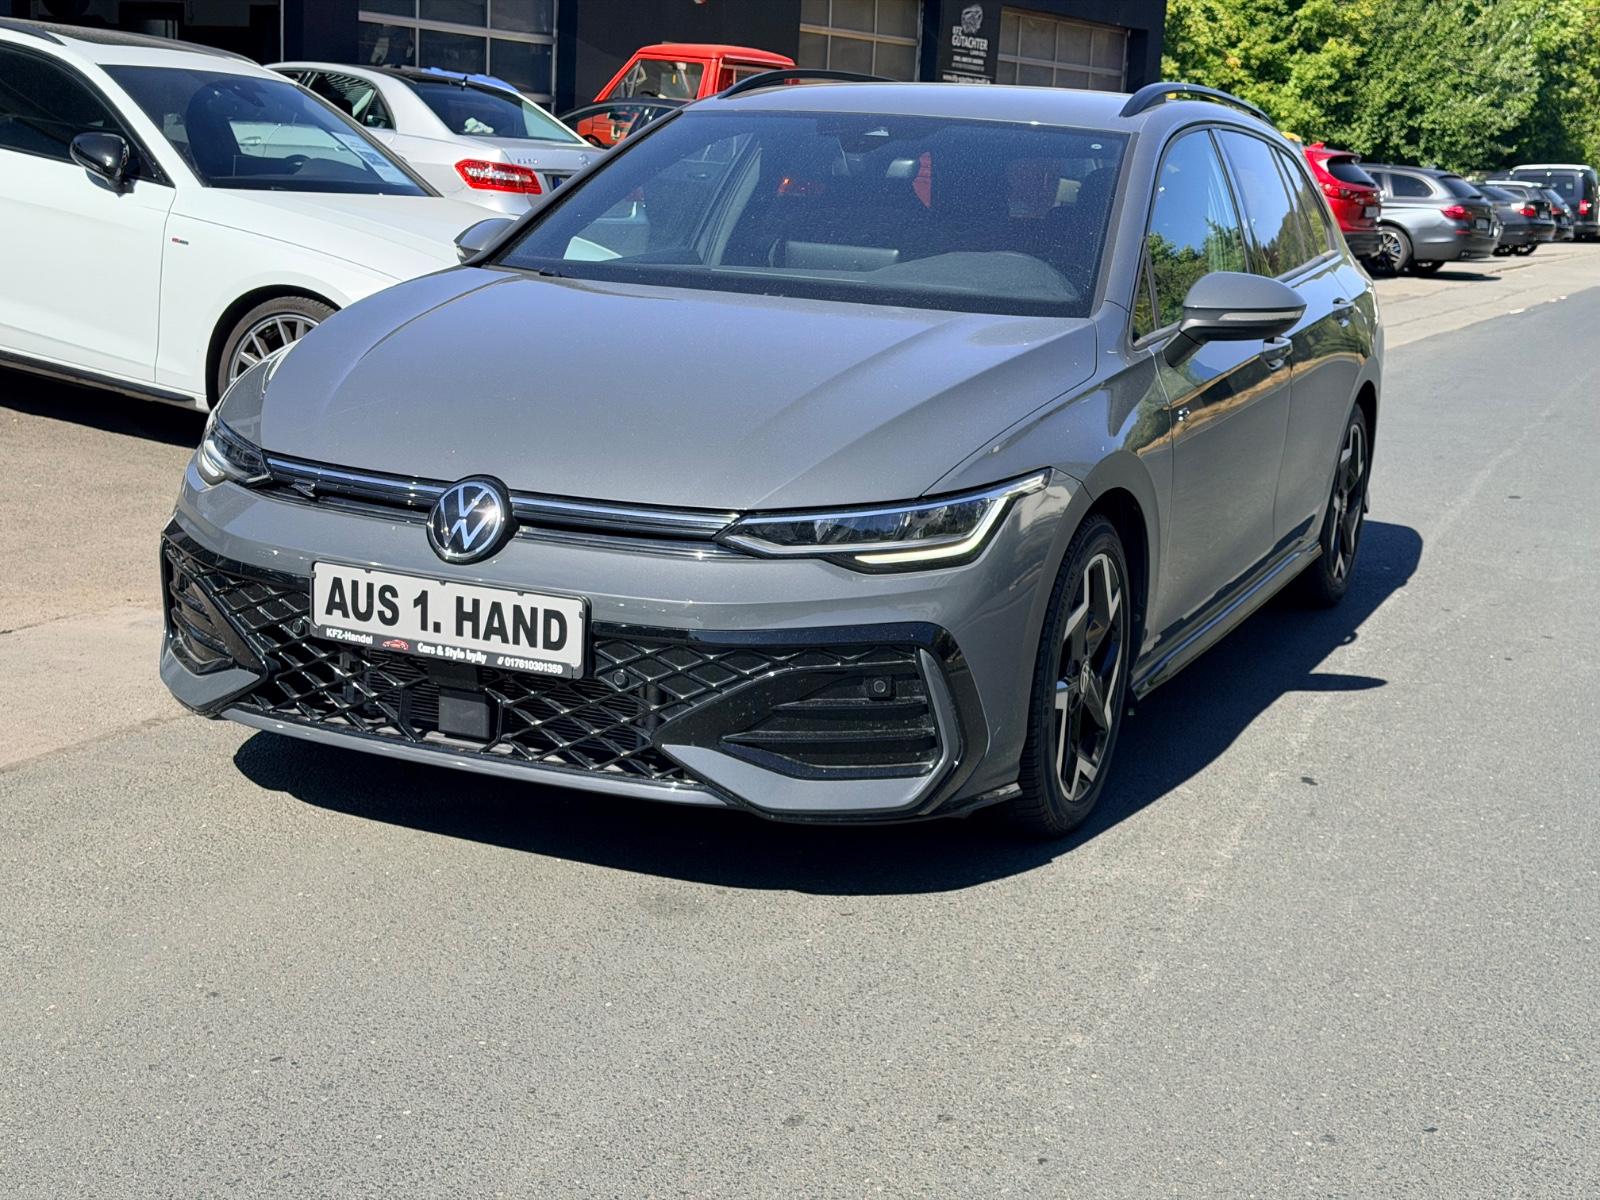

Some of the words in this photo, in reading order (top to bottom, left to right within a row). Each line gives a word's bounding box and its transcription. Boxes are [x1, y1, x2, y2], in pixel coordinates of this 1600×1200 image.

[952, 34, 988, 51] GUTACHTER
[325, 576, 400, 627] AUS
[413, 589, 442, 634] 1.
[455, 595, 568, 652] HAND
[326, 628, 374, 645] KFZ-Handel
[417, 642, 436, 655] Cars
[436, 645, 444, 657] &
[445, 646, 466, 661] Style
[504, 656, 563, 674] 017610301359
